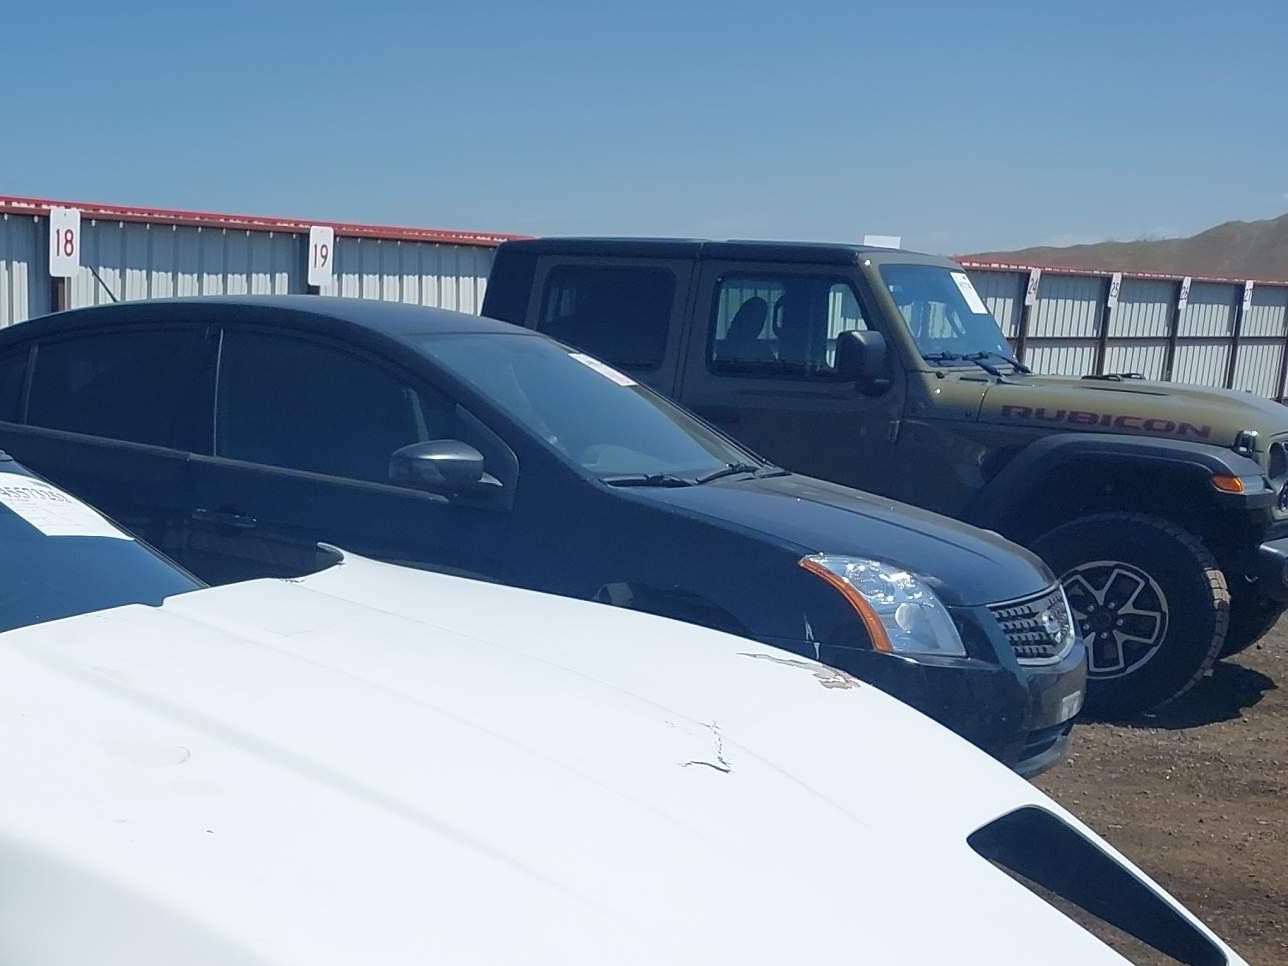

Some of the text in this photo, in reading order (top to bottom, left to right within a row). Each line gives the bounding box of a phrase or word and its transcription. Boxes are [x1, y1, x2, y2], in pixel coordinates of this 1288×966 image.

[56, 228, 74, 257] 18
[314, 243, 329, 268] 19
[1027, 278, 1039, 295] 24
[1110, 281, 1120, 298] 25
[1000, 404, 1212, 439] RUBICON
